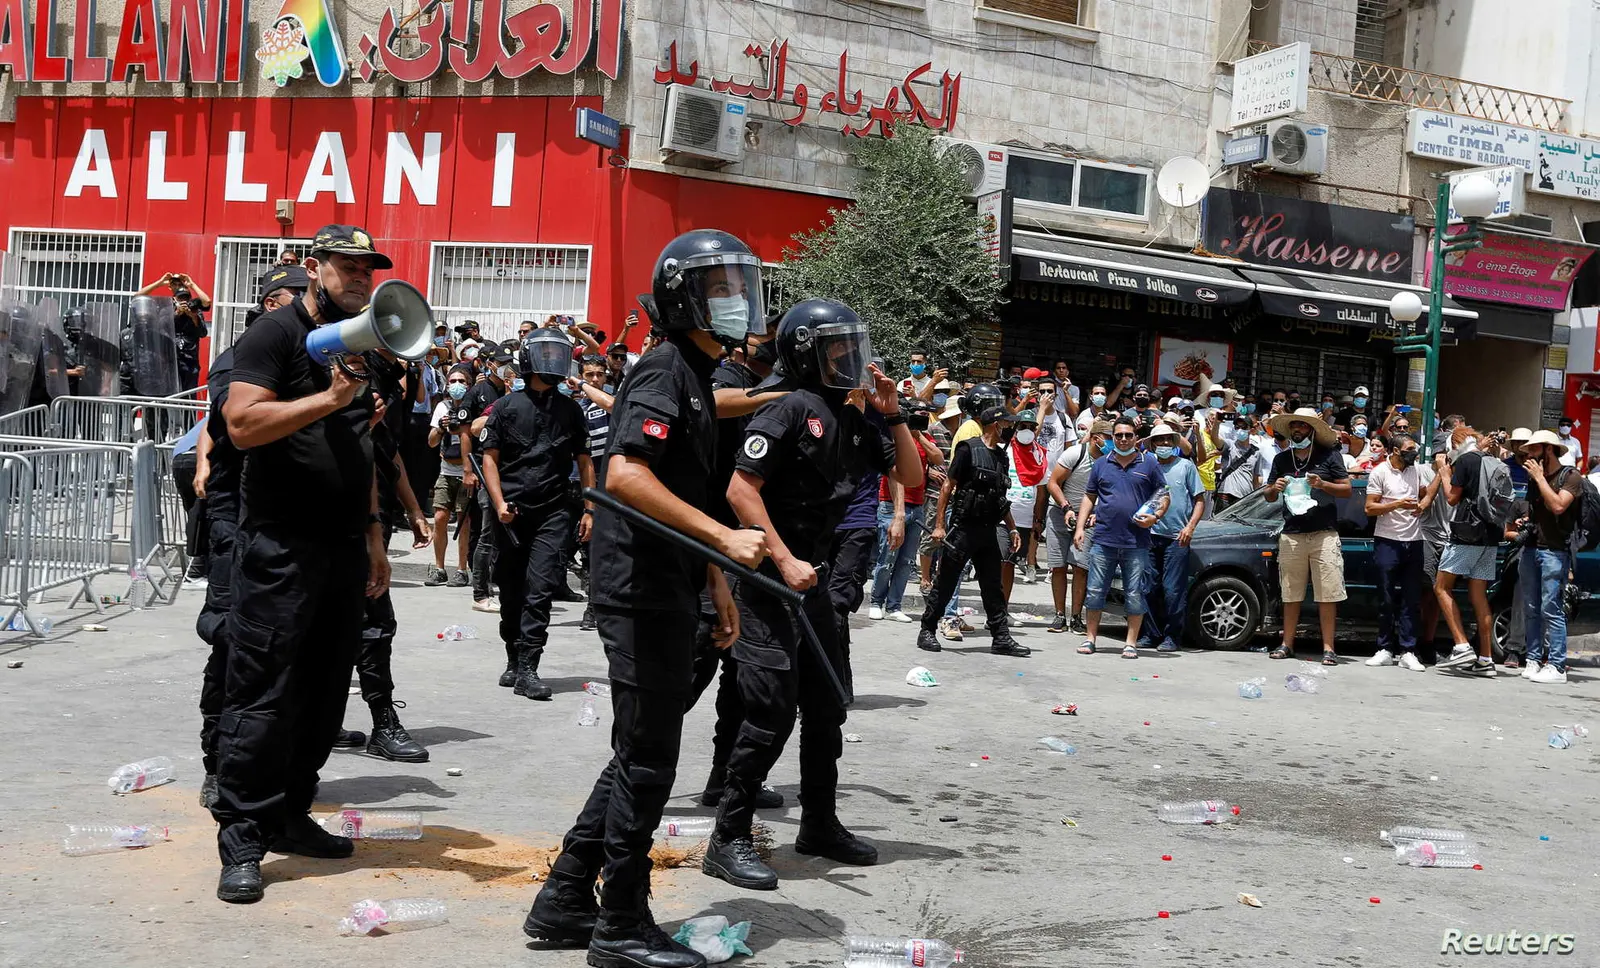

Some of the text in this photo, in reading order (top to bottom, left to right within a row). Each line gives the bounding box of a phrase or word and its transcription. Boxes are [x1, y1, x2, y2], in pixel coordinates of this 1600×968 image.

[1263, 102, 1276, 114] 221
[1278, 98, 1291, 110] 450
[589, 119, 617, 138] SAMSUNG
[1417, 141, 1455, 157] CENTRE
[1459, 149, 1473, 160] DE
[1447, 134, 1505, 153] CIMBA
[64, 129, 517, 207] ALLANI
[1038, 261, 1100, 284] Restaurant
[1107, 271, 1138, 289] Pizza
[1146, 276, 1179, 296] Sultan
[1477, 260, 1537, 278] 6 ème Étage
[1336, 308, 1378, 325] السلطان
